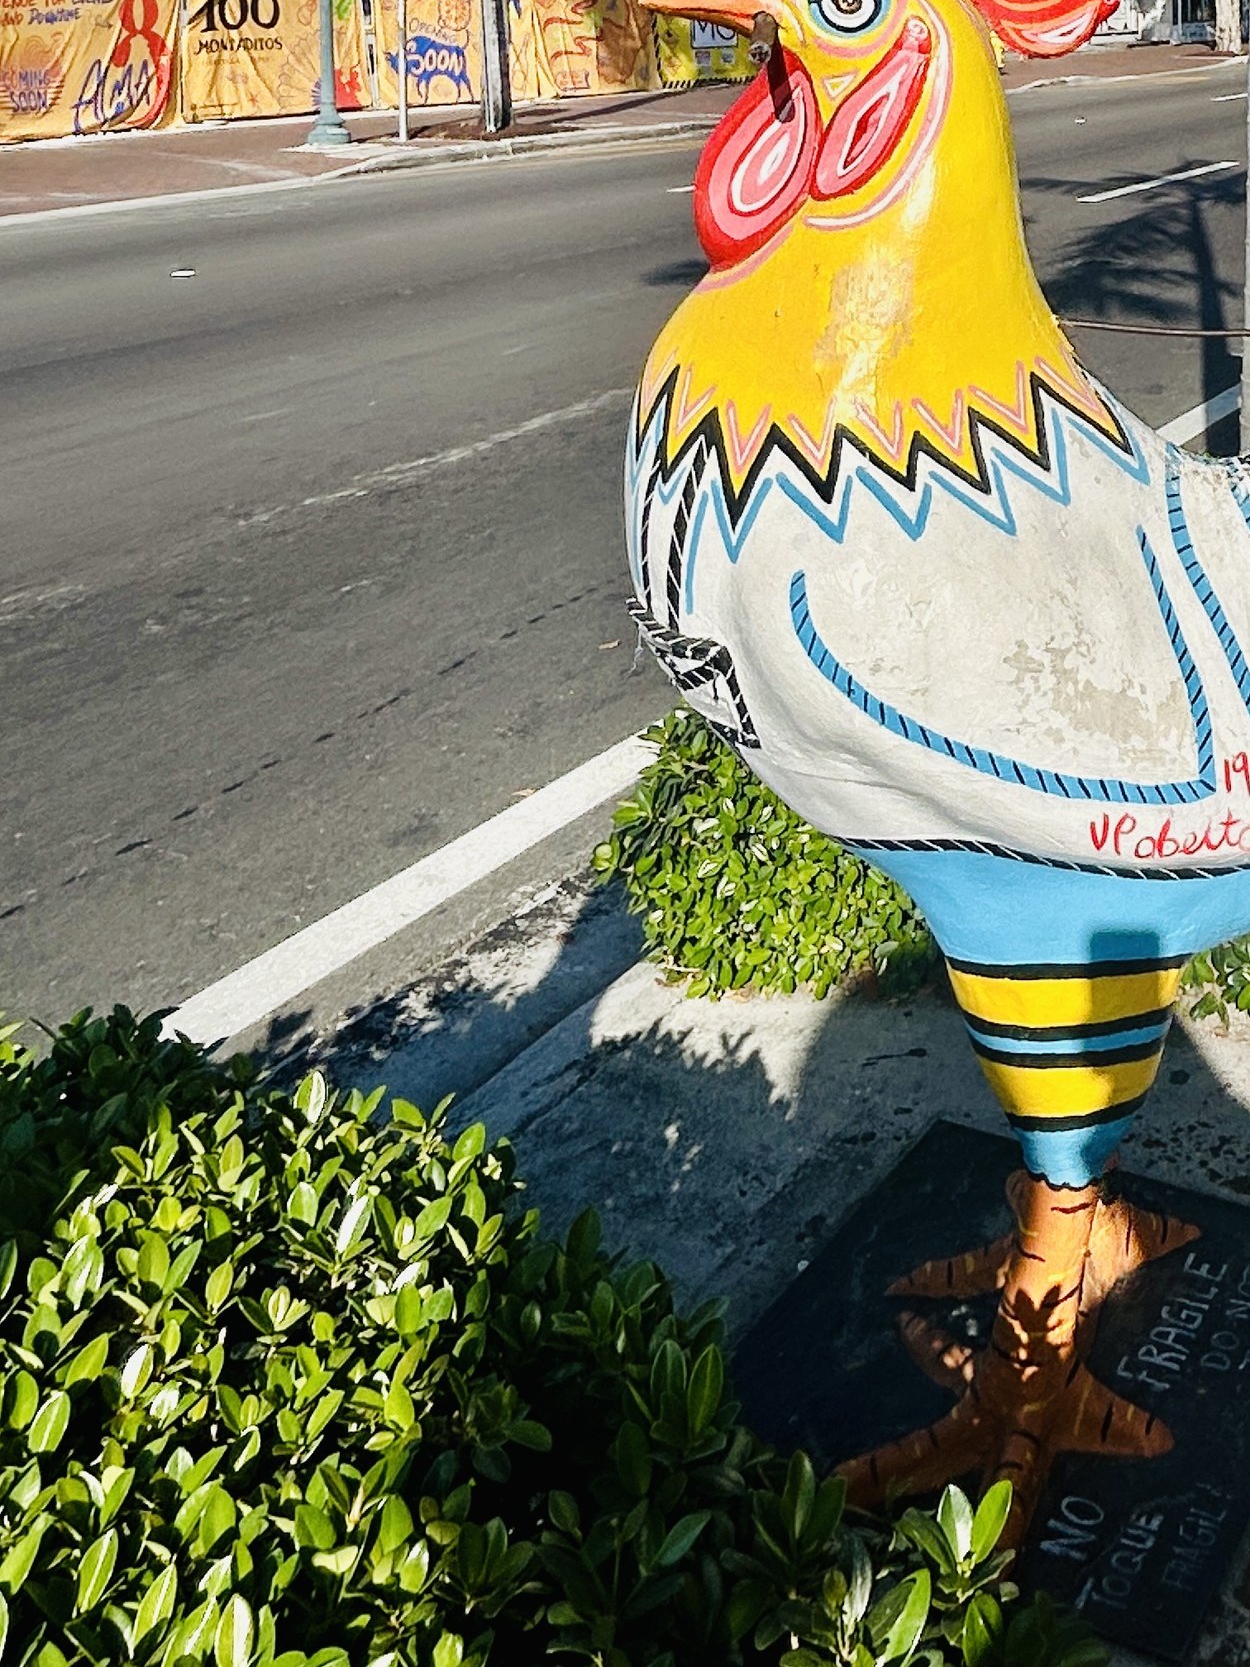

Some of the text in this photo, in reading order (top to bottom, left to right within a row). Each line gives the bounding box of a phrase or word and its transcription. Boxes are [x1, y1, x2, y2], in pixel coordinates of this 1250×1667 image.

[195, 37, 283, 55] MONTADITOS
[405, 40, 464, 76] SOON
[10, 90, 48, 113] SOON
[1117, 1252, 1229, 1393] FRAGILE
[1200, 1330, 1240, 1372] DO
[1039, 1494, 1106, 1562] NO
[1073, 1509, 1167, 1611] TOQUE
